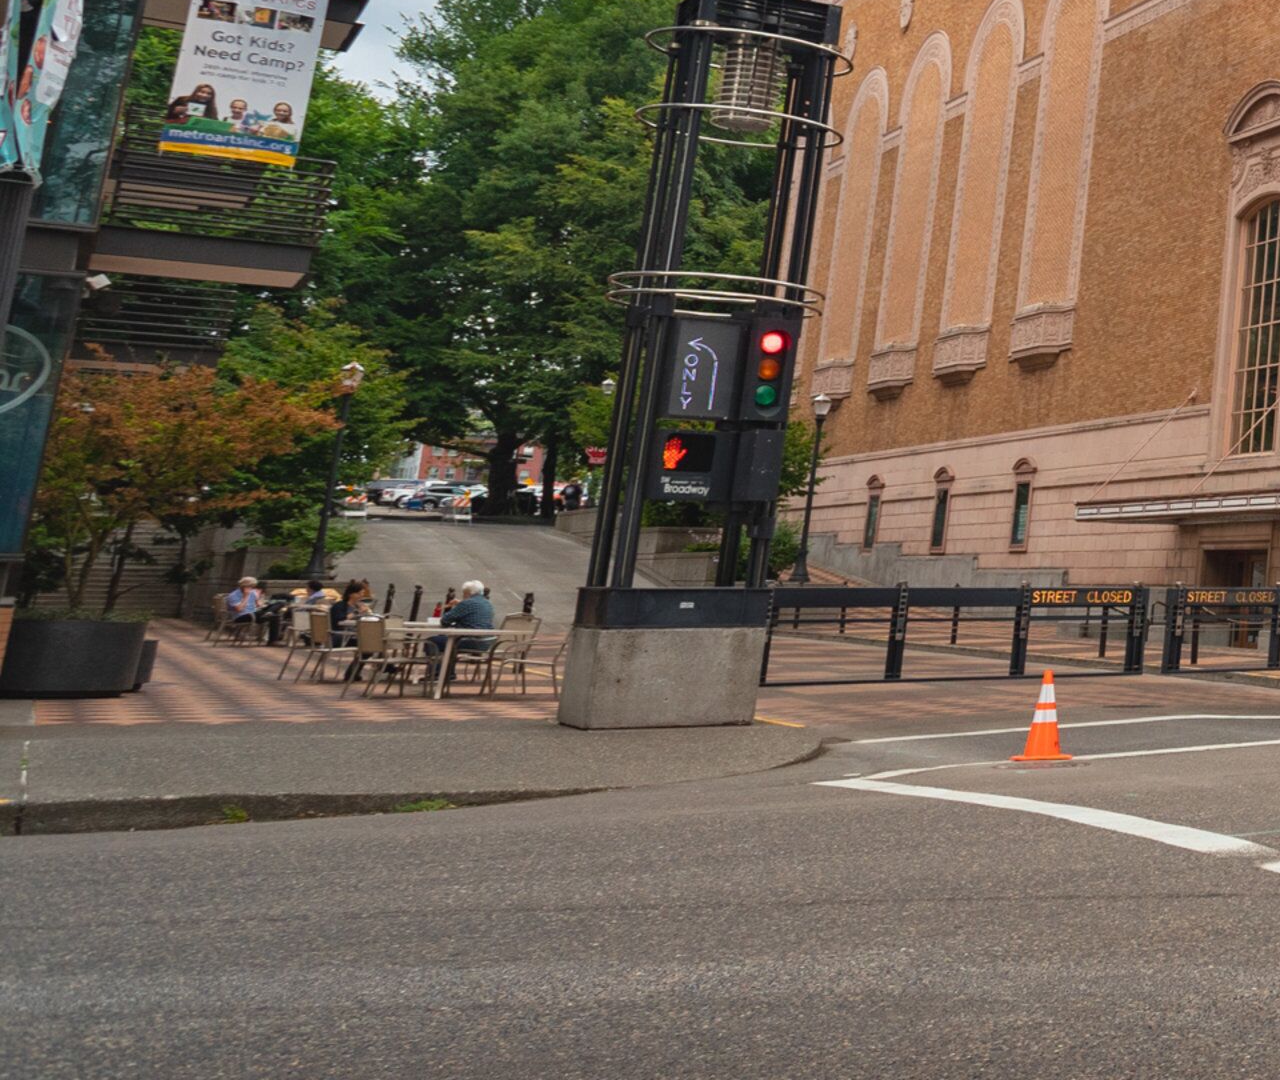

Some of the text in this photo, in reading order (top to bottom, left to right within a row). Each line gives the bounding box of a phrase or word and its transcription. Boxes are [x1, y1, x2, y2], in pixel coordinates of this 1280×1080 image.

[211, 30, 295, 54] Got Kids?
[193, 45, 305, 72] Need Camp?
[168, 127, 293, 154] metroartsinc.org
[680, 353, 699, 410] ONLY
[663, 483, 710, 496] Broadway
[1031, 590, 1133, 604] STREET CLOSED
[1186, 590, 1275, 603] STREET CLOSED
